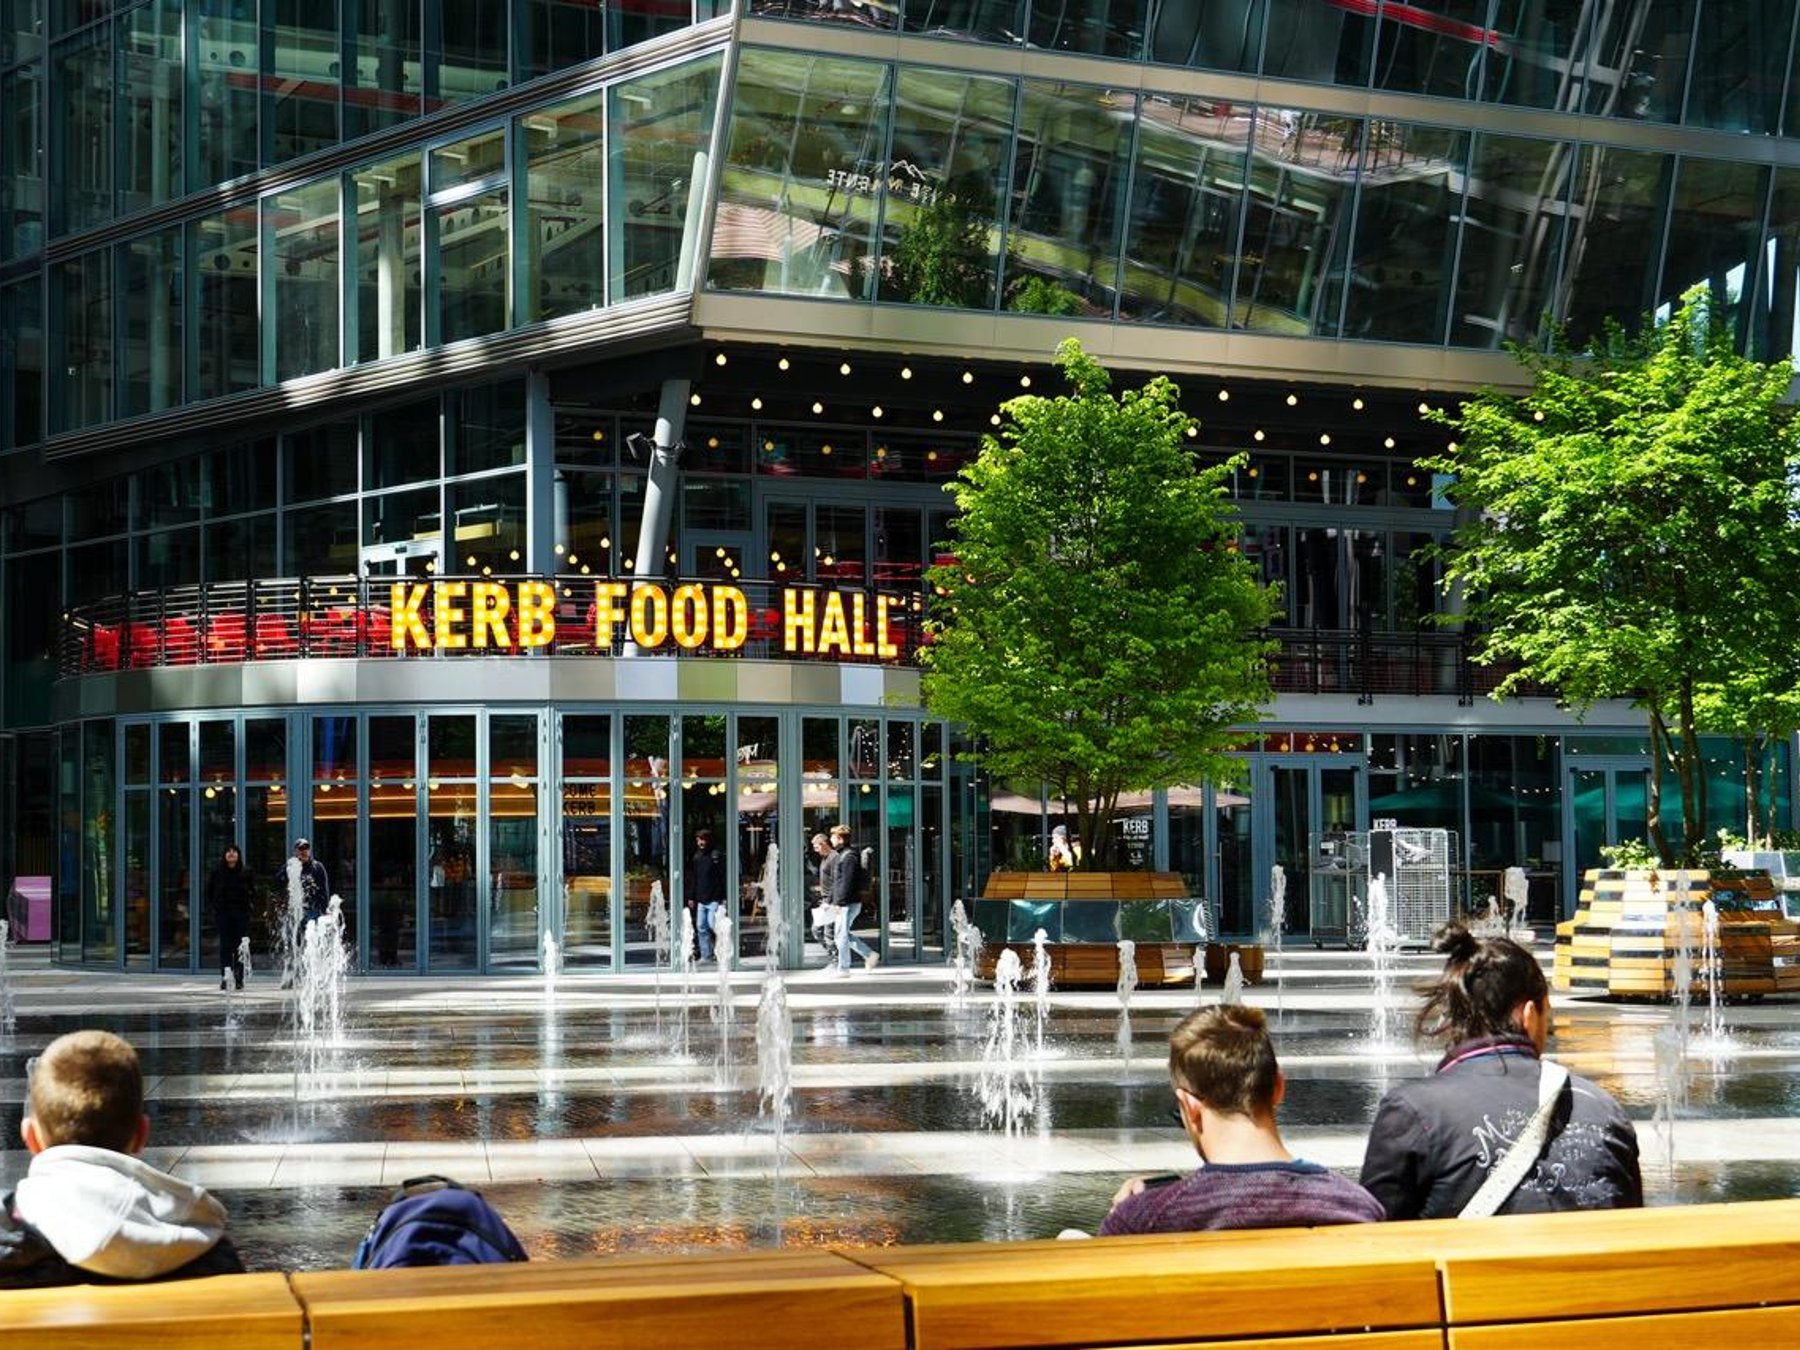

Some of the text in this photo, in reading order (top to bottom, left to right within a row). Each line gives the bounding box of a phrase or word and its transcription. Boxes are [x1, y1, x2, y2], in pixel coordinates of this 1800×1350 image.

[391, 582, 899, 657] KERB FOOD HALL
[1123, 819, 1149, 834] KERB
